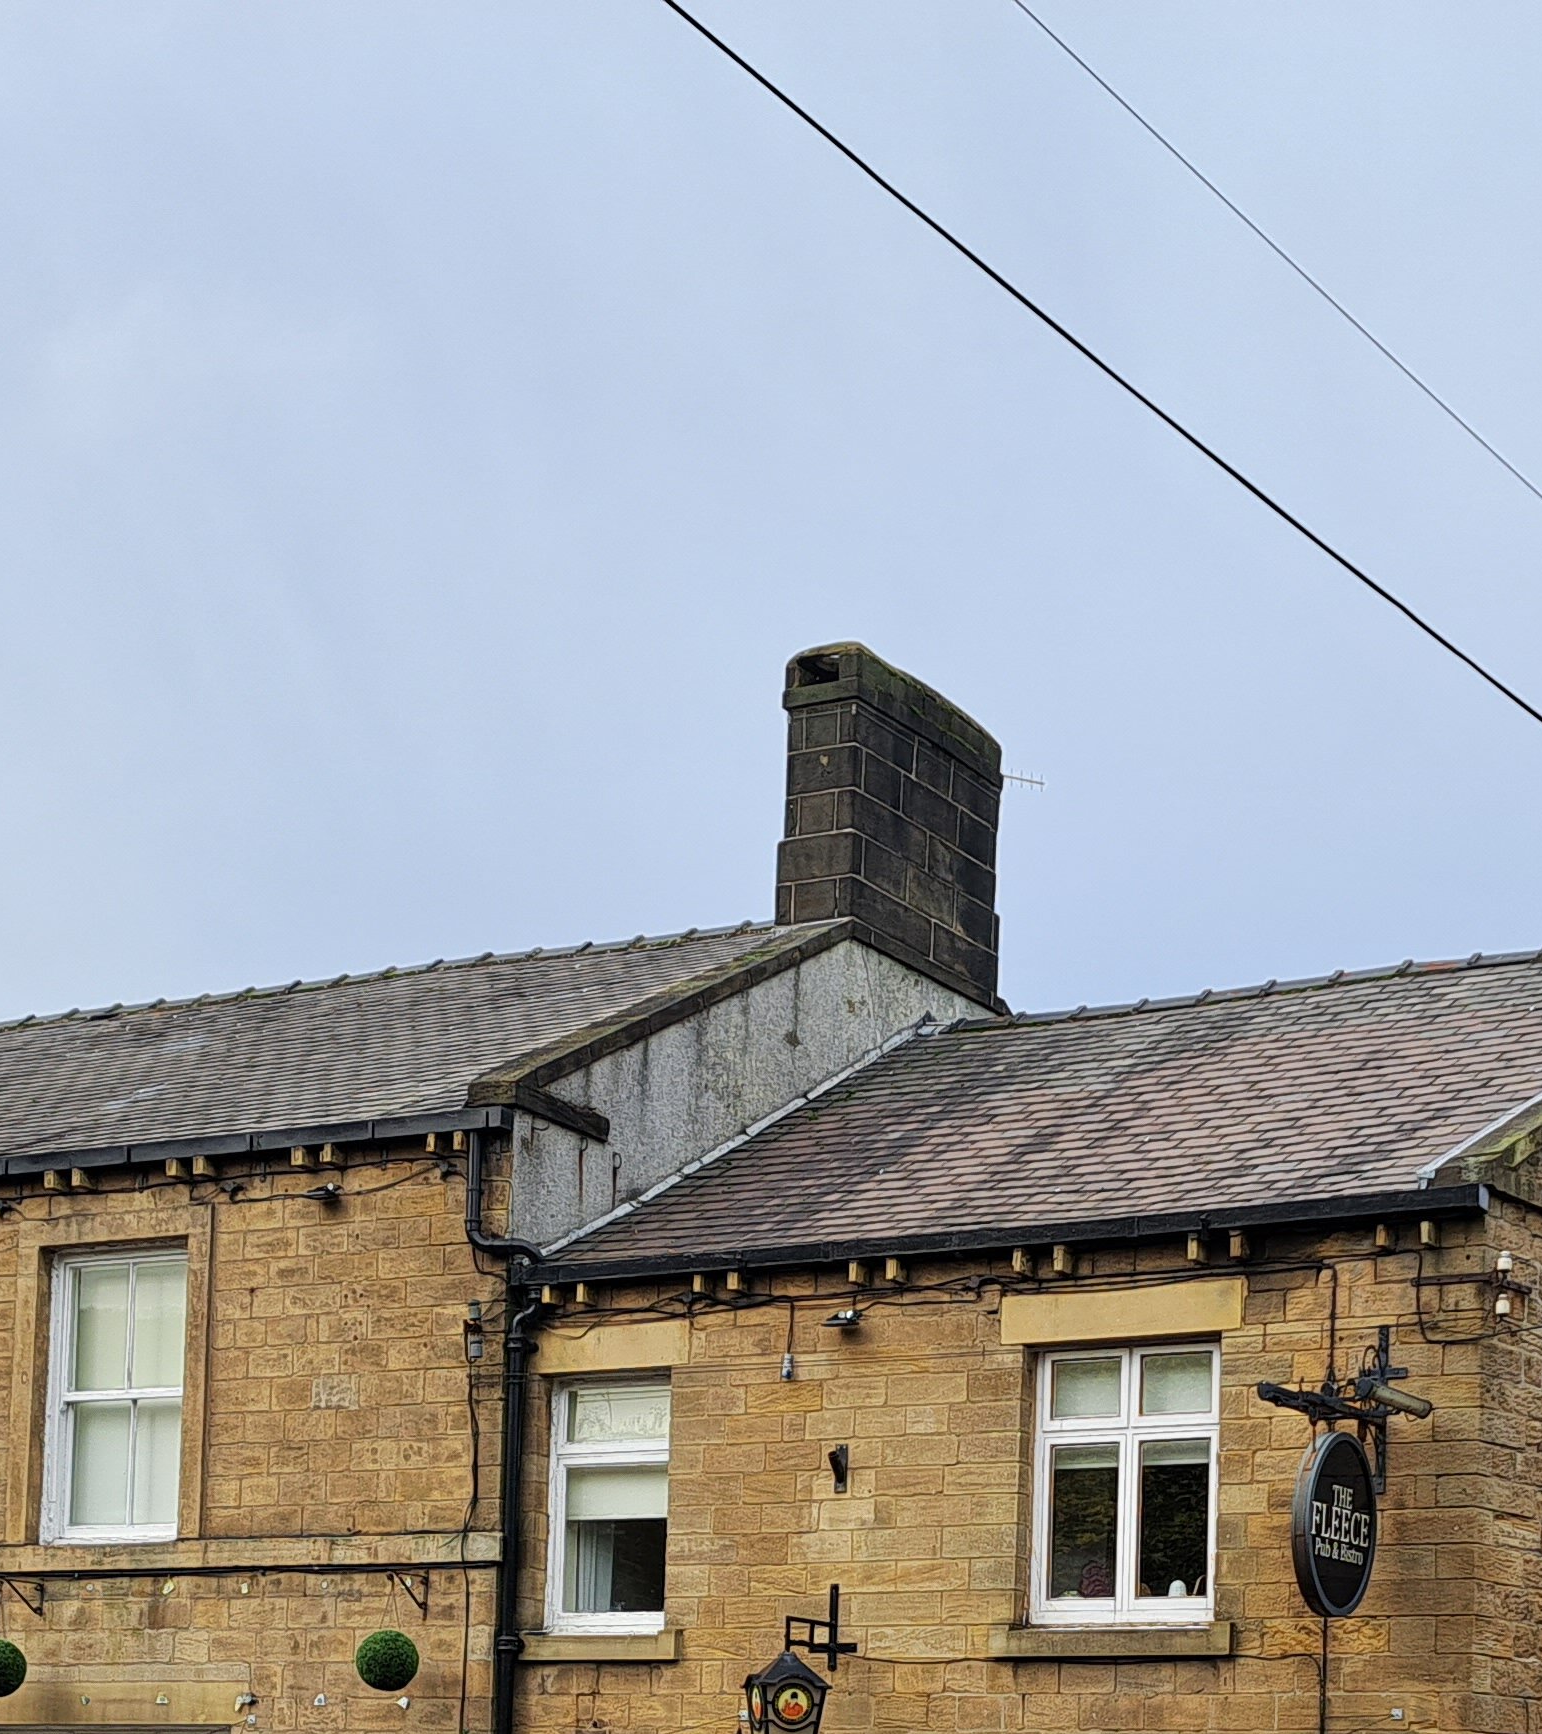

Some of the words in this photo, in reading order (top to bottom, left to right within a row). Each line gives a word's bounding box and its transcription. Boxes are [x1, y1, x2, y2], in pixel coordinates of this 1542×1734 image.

[1332, 1484, 1354, 1510] THE
[1310, 1500, 1370, 1548] FLEECE
[1315, 1537, 1331, 1558] Pub
[1340, 1543, 1363, 1566] Bistro
